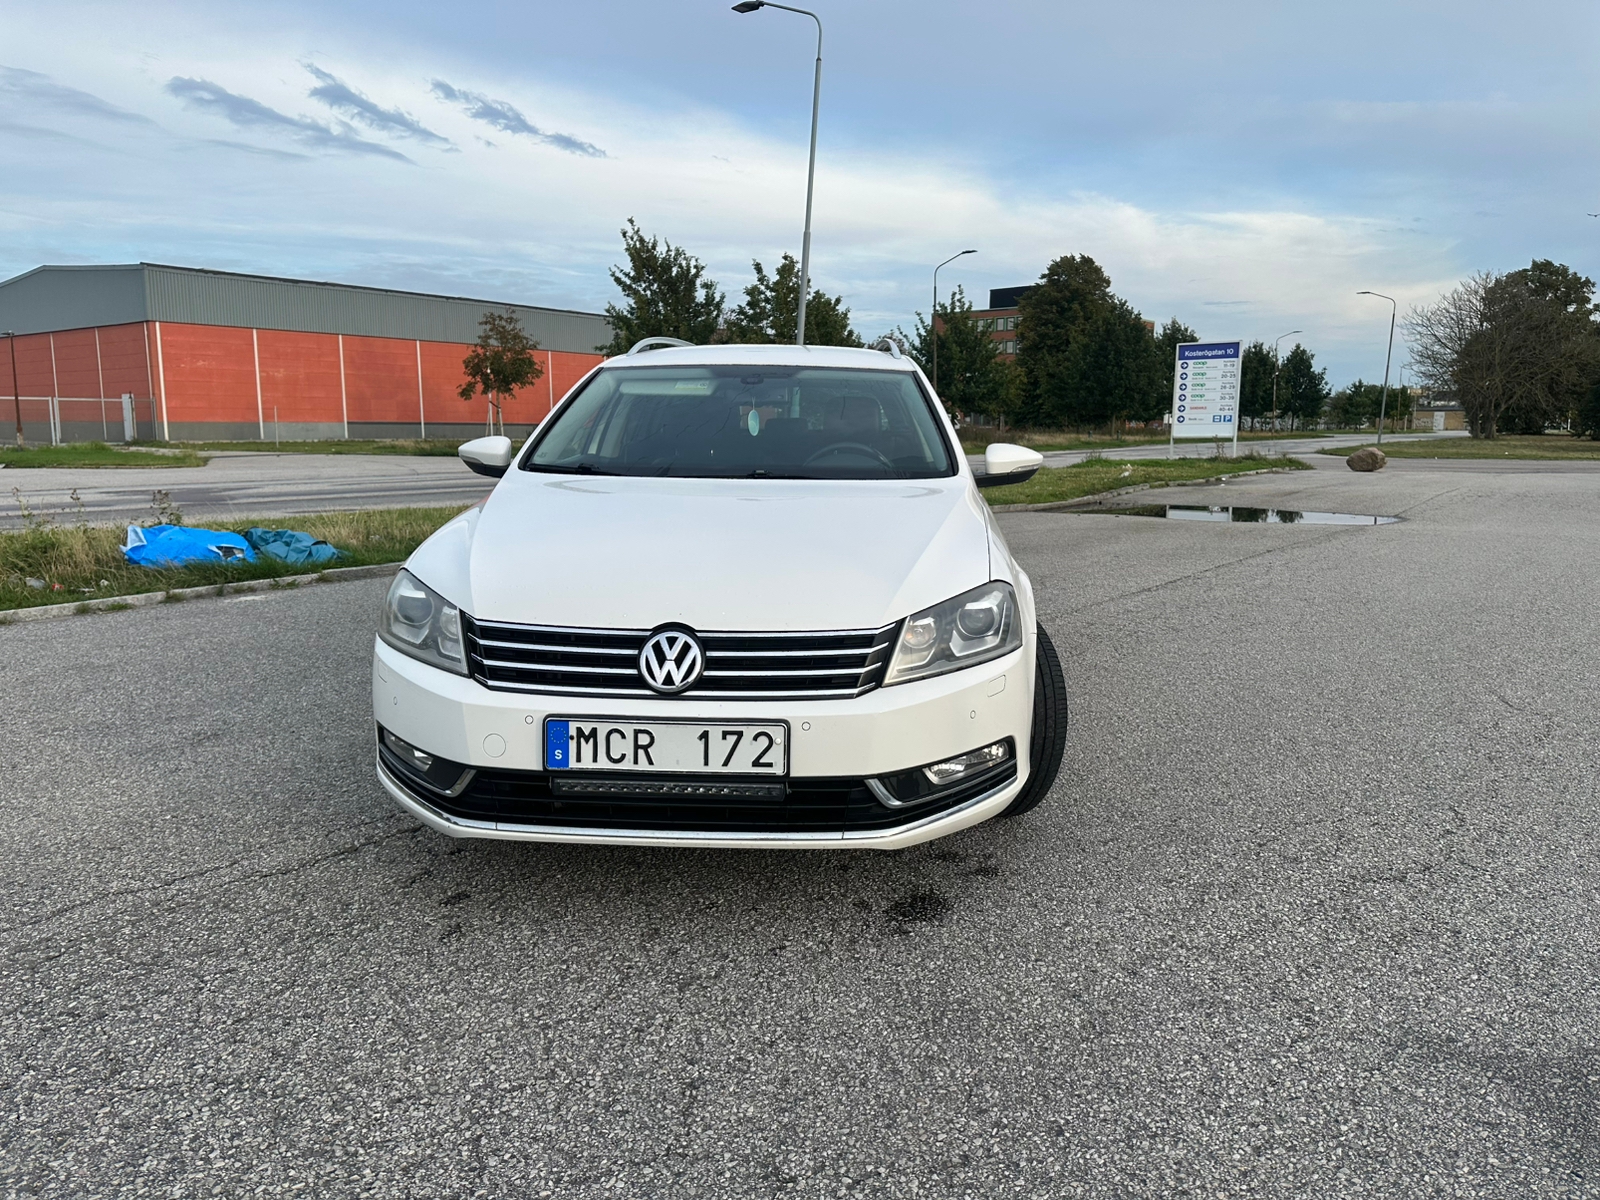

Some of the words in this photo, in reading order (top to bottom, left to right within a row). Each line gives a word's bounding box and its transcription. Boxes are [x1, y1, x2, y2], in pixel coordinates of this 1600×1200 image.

[1185, 349, 1225, 357] Kosterögatan
[575, 726, 655, 766] MCR
[697, 730, 774, 768] 172
[554, 750, 562, 760] S
